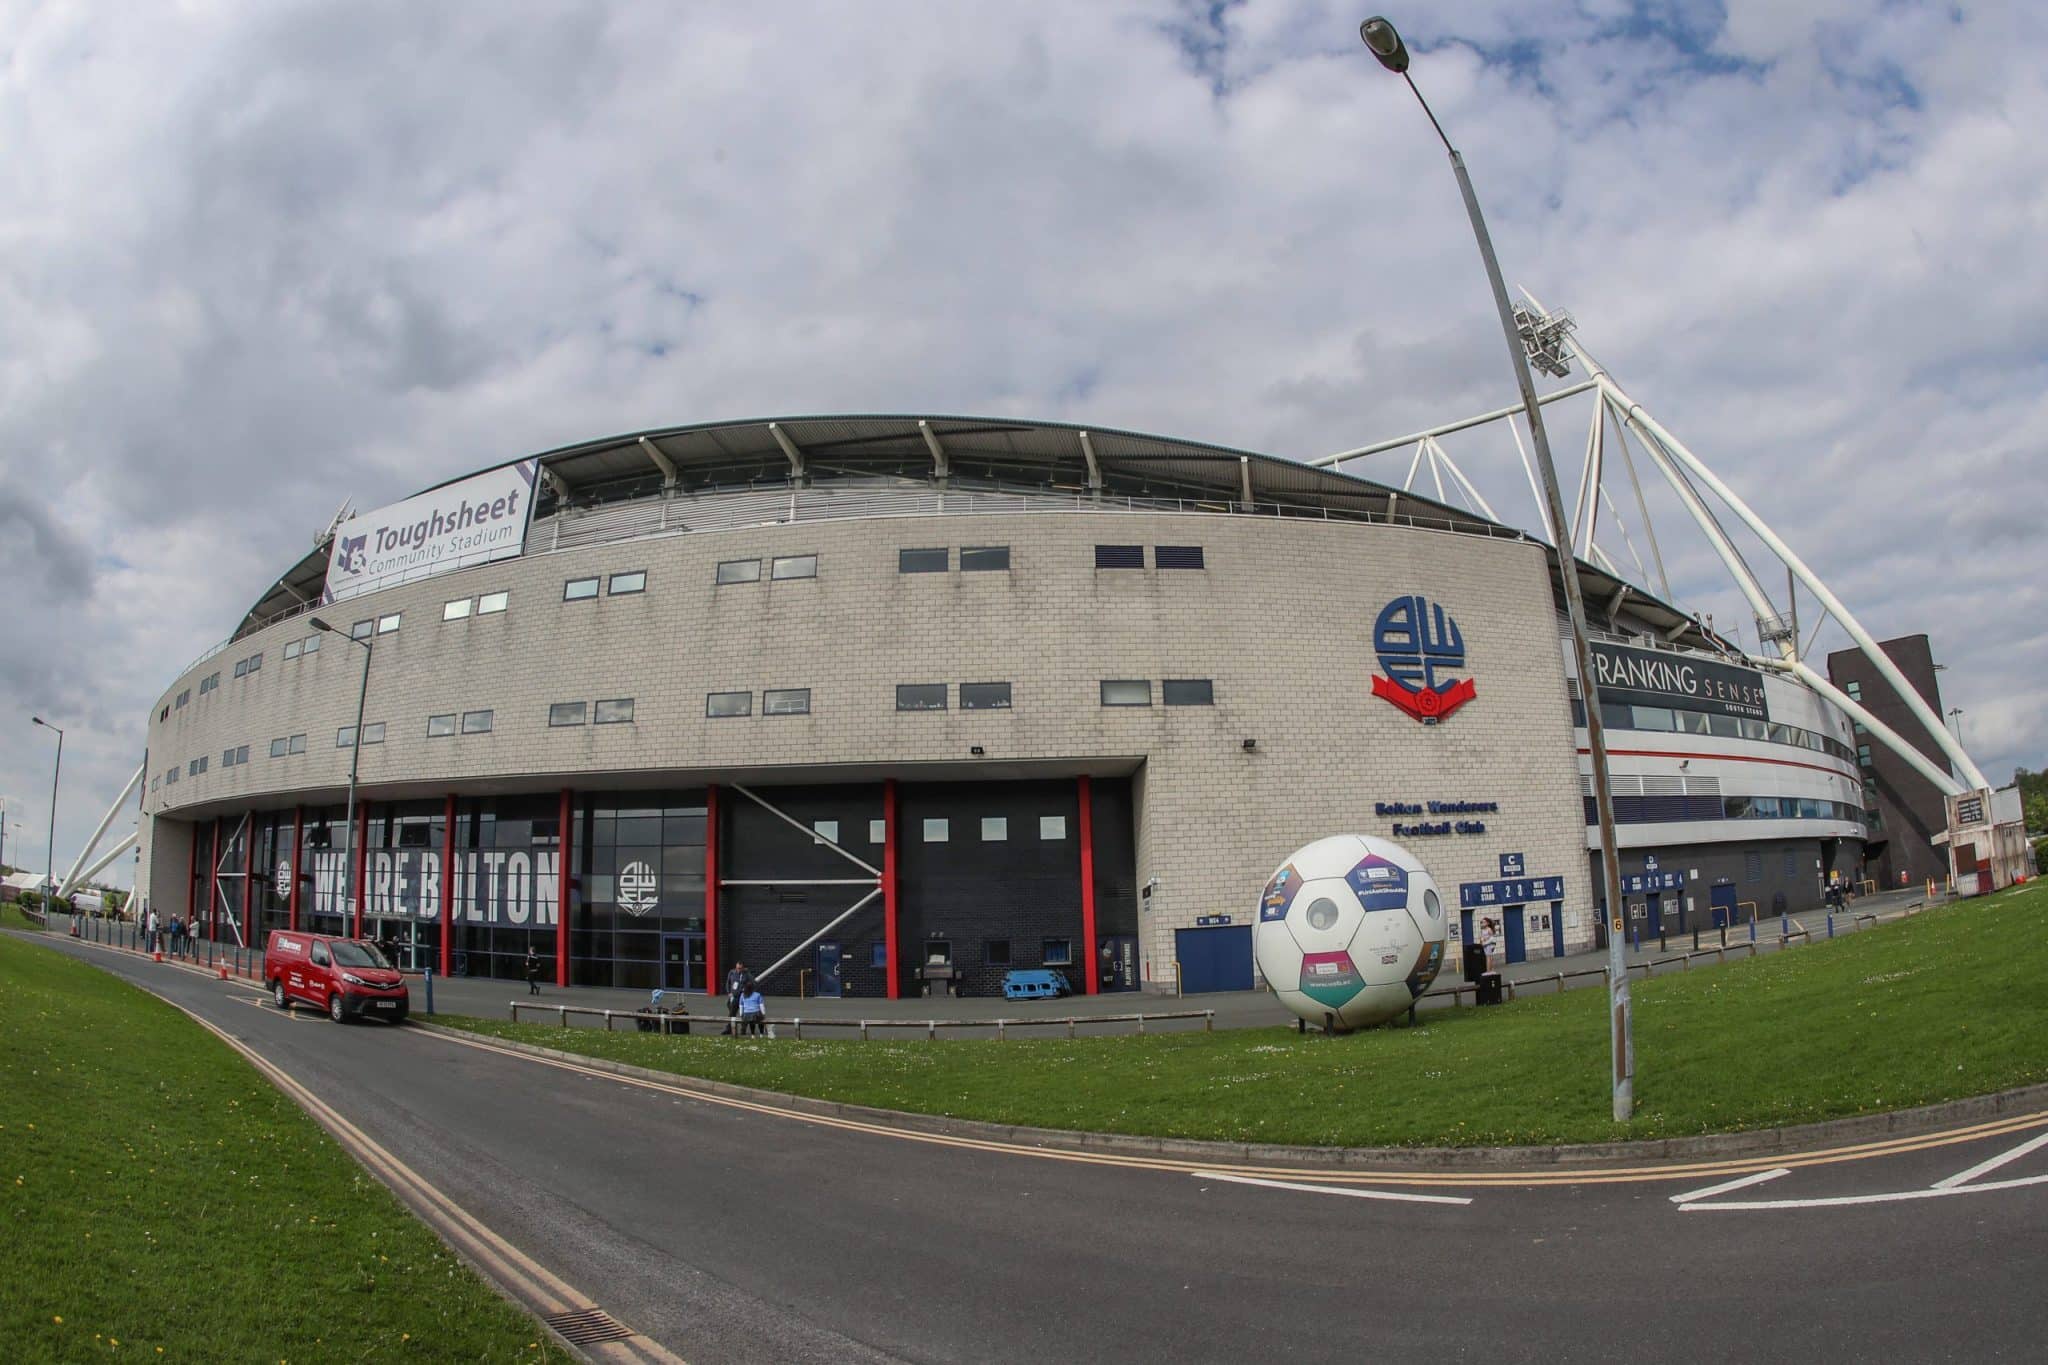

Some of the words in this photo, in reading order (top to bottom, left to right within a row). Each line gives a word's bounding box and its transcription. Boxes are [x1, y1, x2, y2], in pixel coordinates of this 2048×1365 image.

[376, 489, 519, 554] Toughsheet
[369, 542, 445, 575] Community
[450, 525, 513, 552] Stadium
[1705, 679, 1761, 705] SENSE
[1375, 802, 1422, 816] Bolton
[1393, 821, 1451, 836] Football
[1455, 820, 1485, 834] Club
[1508, 855, 1516, 865] C
[1505, 885, 1511, 898] 2
[1555, 881, 1561, 894] 4
[1464, 888, 1469, 902] 1
[1615, 920, 1622, 930] 6
